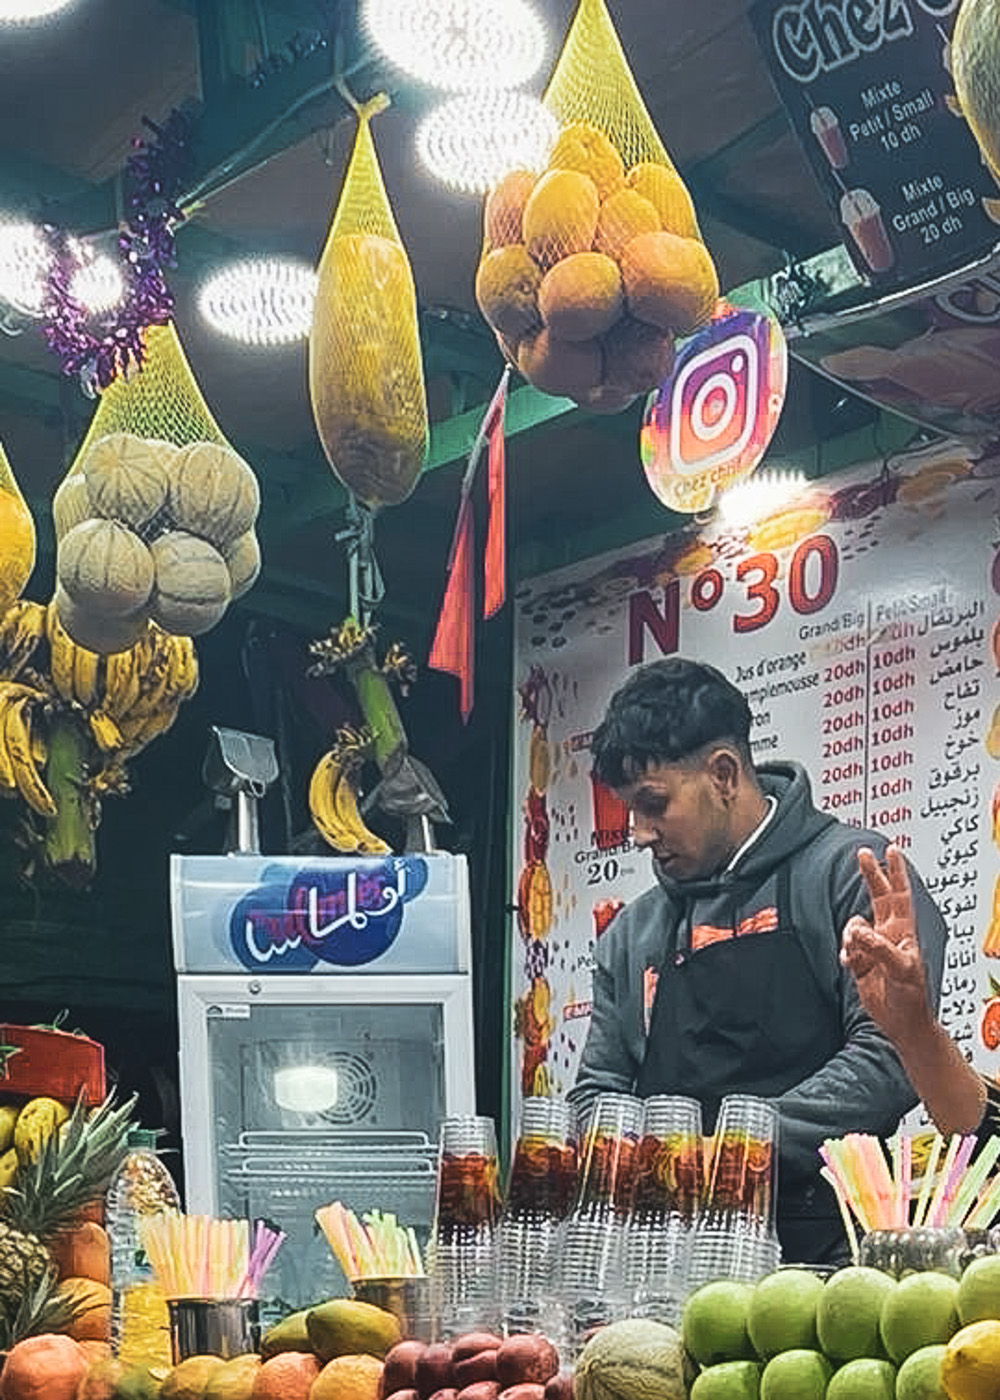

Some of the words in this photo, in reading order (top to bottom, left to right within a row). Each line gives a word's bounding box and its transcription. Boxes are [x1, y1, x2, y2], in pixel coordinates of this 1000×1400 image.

[860, 80, 902, 109] Mixte
[891, 91, 934, 121] Small
[880, 132, 898, 152] 10
[900, 123, 922, 144] dh
[901, 174, 944, 202] Mixte
[892, 203, 938, 232] Grand
[946, 187, 976, 212] Big
[920, 224, 940, 244] 20
[941, 214, 962, 235] dh
[799, 622, 838, 641] Grand
[918, 601, 984, 636] البرتقال
[824, 660, 865, 683] 20dh
[873, 645, 916, 670] 10dh
[930, 655, 984, 685] حامض
[823, 684, 865, 708] 20dh
[872, 671, 915, 695] 10dh
[944, 679, 980, 711] تفاح
[822, 710, 864, 734] 20dh
[872, 697, 914, 722] 10dh
[954, 708, 980, 730] موز
[822, 735, 864, 758] 20dh
[871, 722, 913, 747] 10dh
[945, 730, 979, 760] خوخ
[821, 761, 863, 784] 20dh
[871, 748, 913, 773] 10dh
[929, 762, 980, 789] برقوق
[821, 787, 863, 810] 20dh
[870, 775, 912, 800] 10dh
[921, 787, 979, 818] زنجبيل
[870, 805, 912, 828] 10dh
[940, 814, 979, 844] كاكي
[587, 860, 618, 885] 20
[940, 976, 976, 996] رمان
